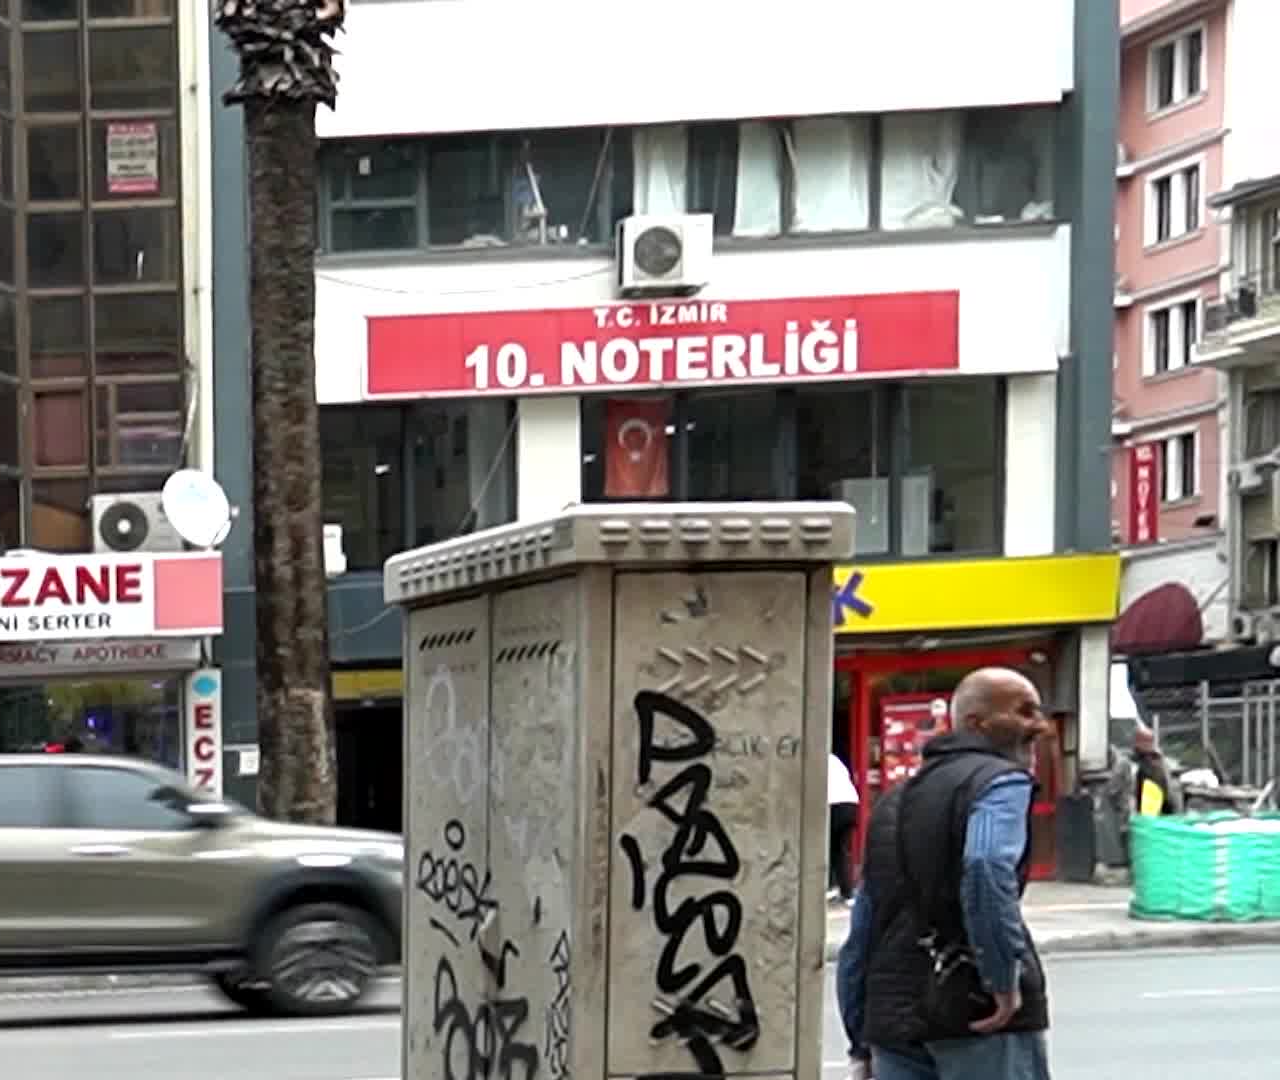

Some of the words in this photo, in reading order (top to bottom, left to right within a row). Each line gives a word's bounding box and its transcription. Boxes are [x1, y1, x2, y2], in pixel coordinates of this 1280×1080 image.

[593, 304, 641, 329] T.C.
[465, 344, 545, 390] 10.
[560, 319, 859, 385] NOTERLİĞİ
[27, 612, 113, 632] SERTER
